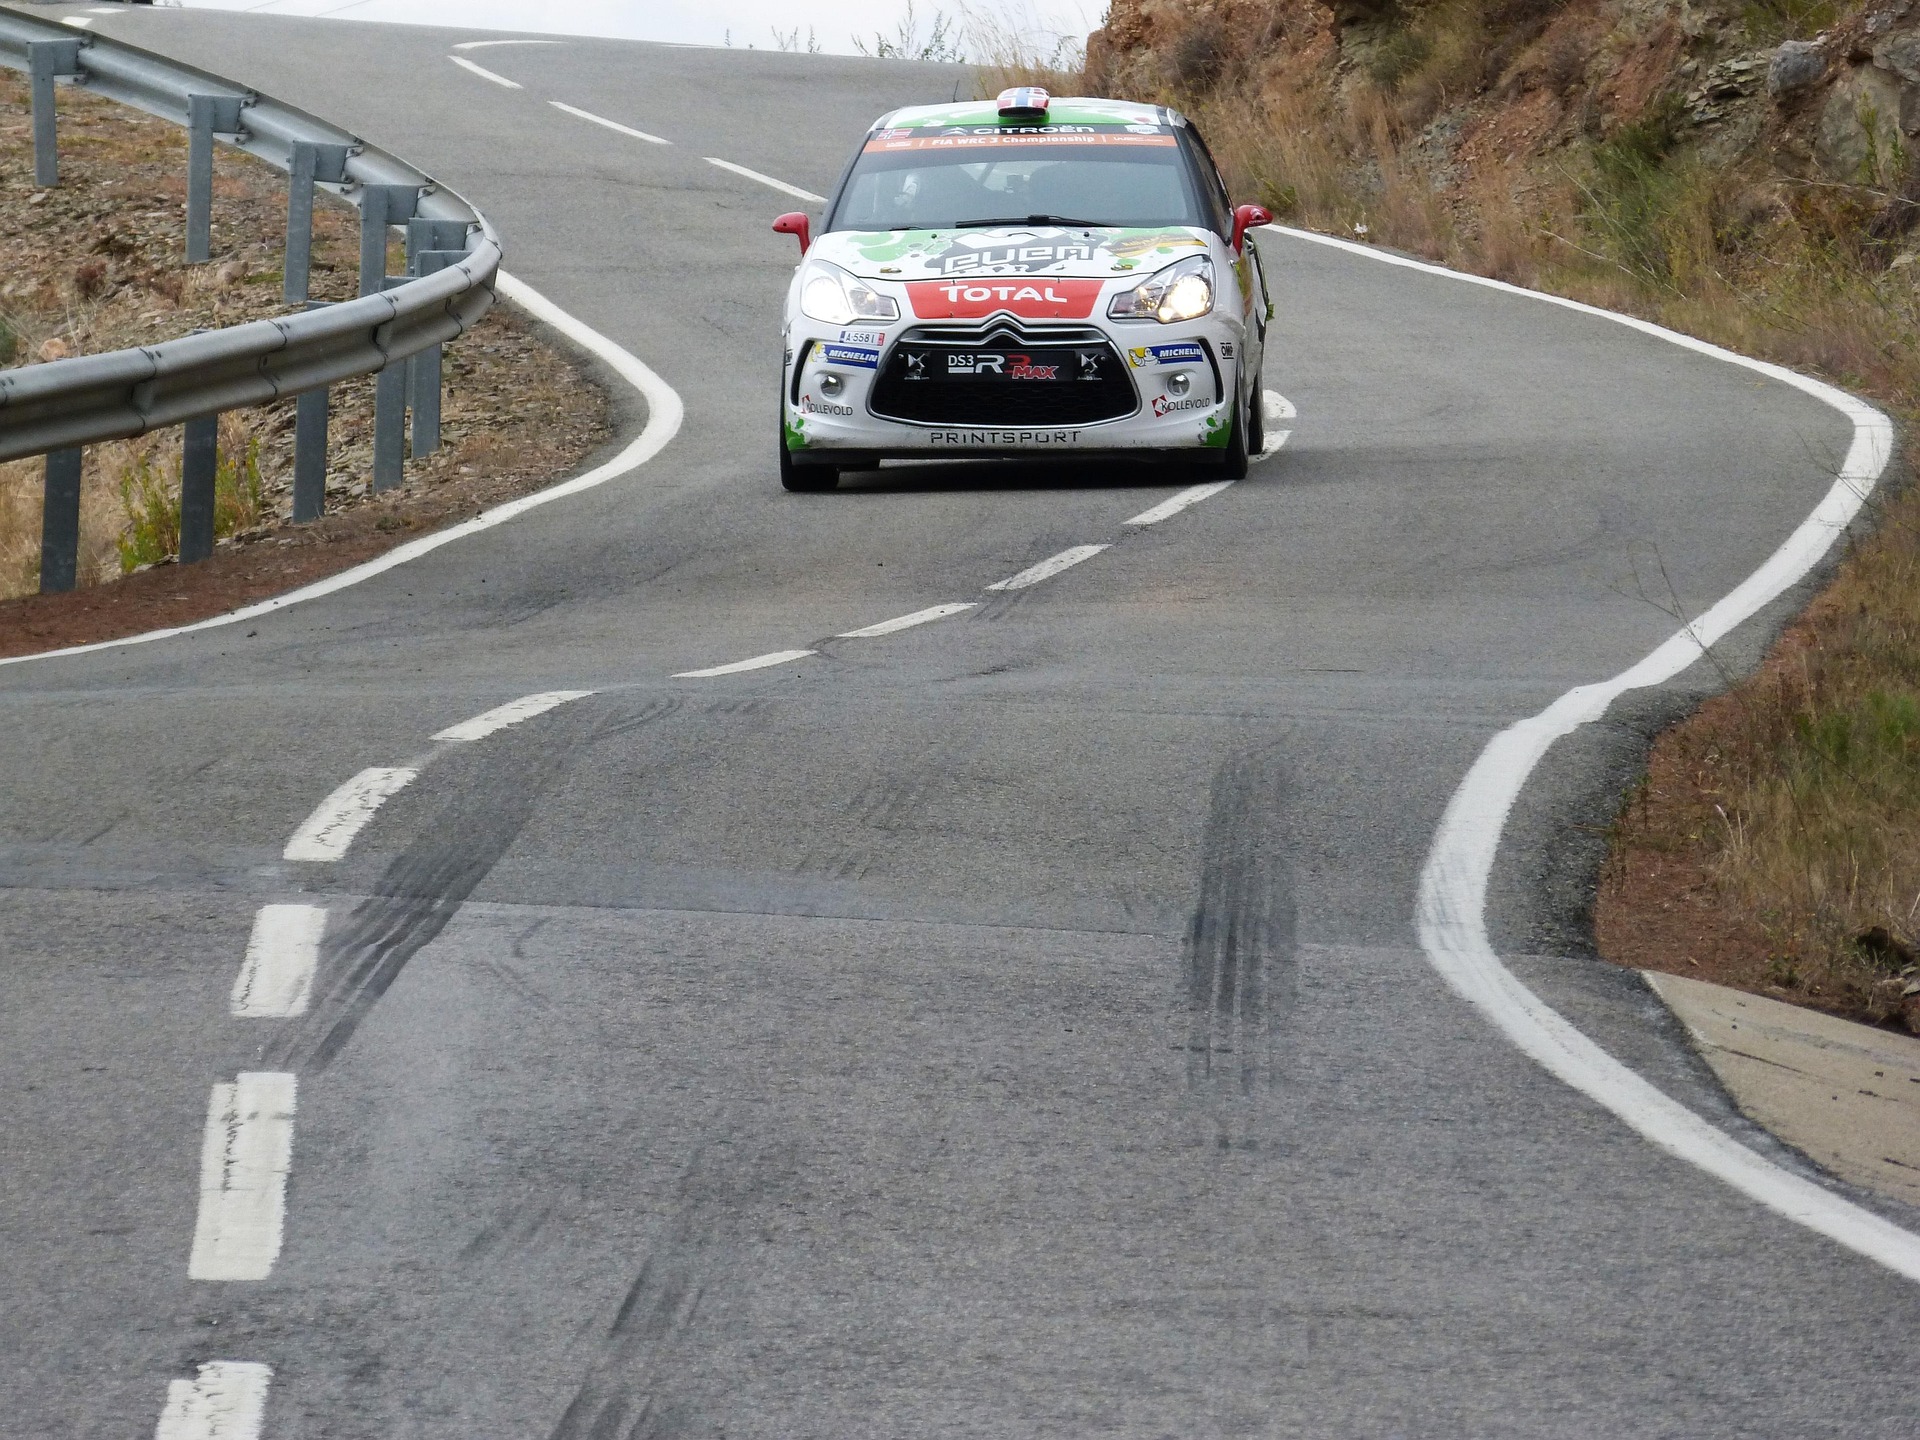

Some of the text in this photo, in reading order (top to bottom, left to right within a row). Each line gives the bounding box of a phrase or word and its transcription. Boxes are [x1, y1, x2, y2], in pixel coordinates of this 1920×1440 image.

[1002, 136, 1095, 144] Championship
[939, 285, 1068, 303] TOTAL
[828, 349, 878, 362] MICHELIN
[1159, 348, 1201, 357] MICHELIN
[948, 355, 974, 366] DS3
[1012, 365, 1059, 380] MAX
[1161, 397, 1210, 412] KOLLEVOLD
[930, 431, 1081, 444] PRINTSPORT
